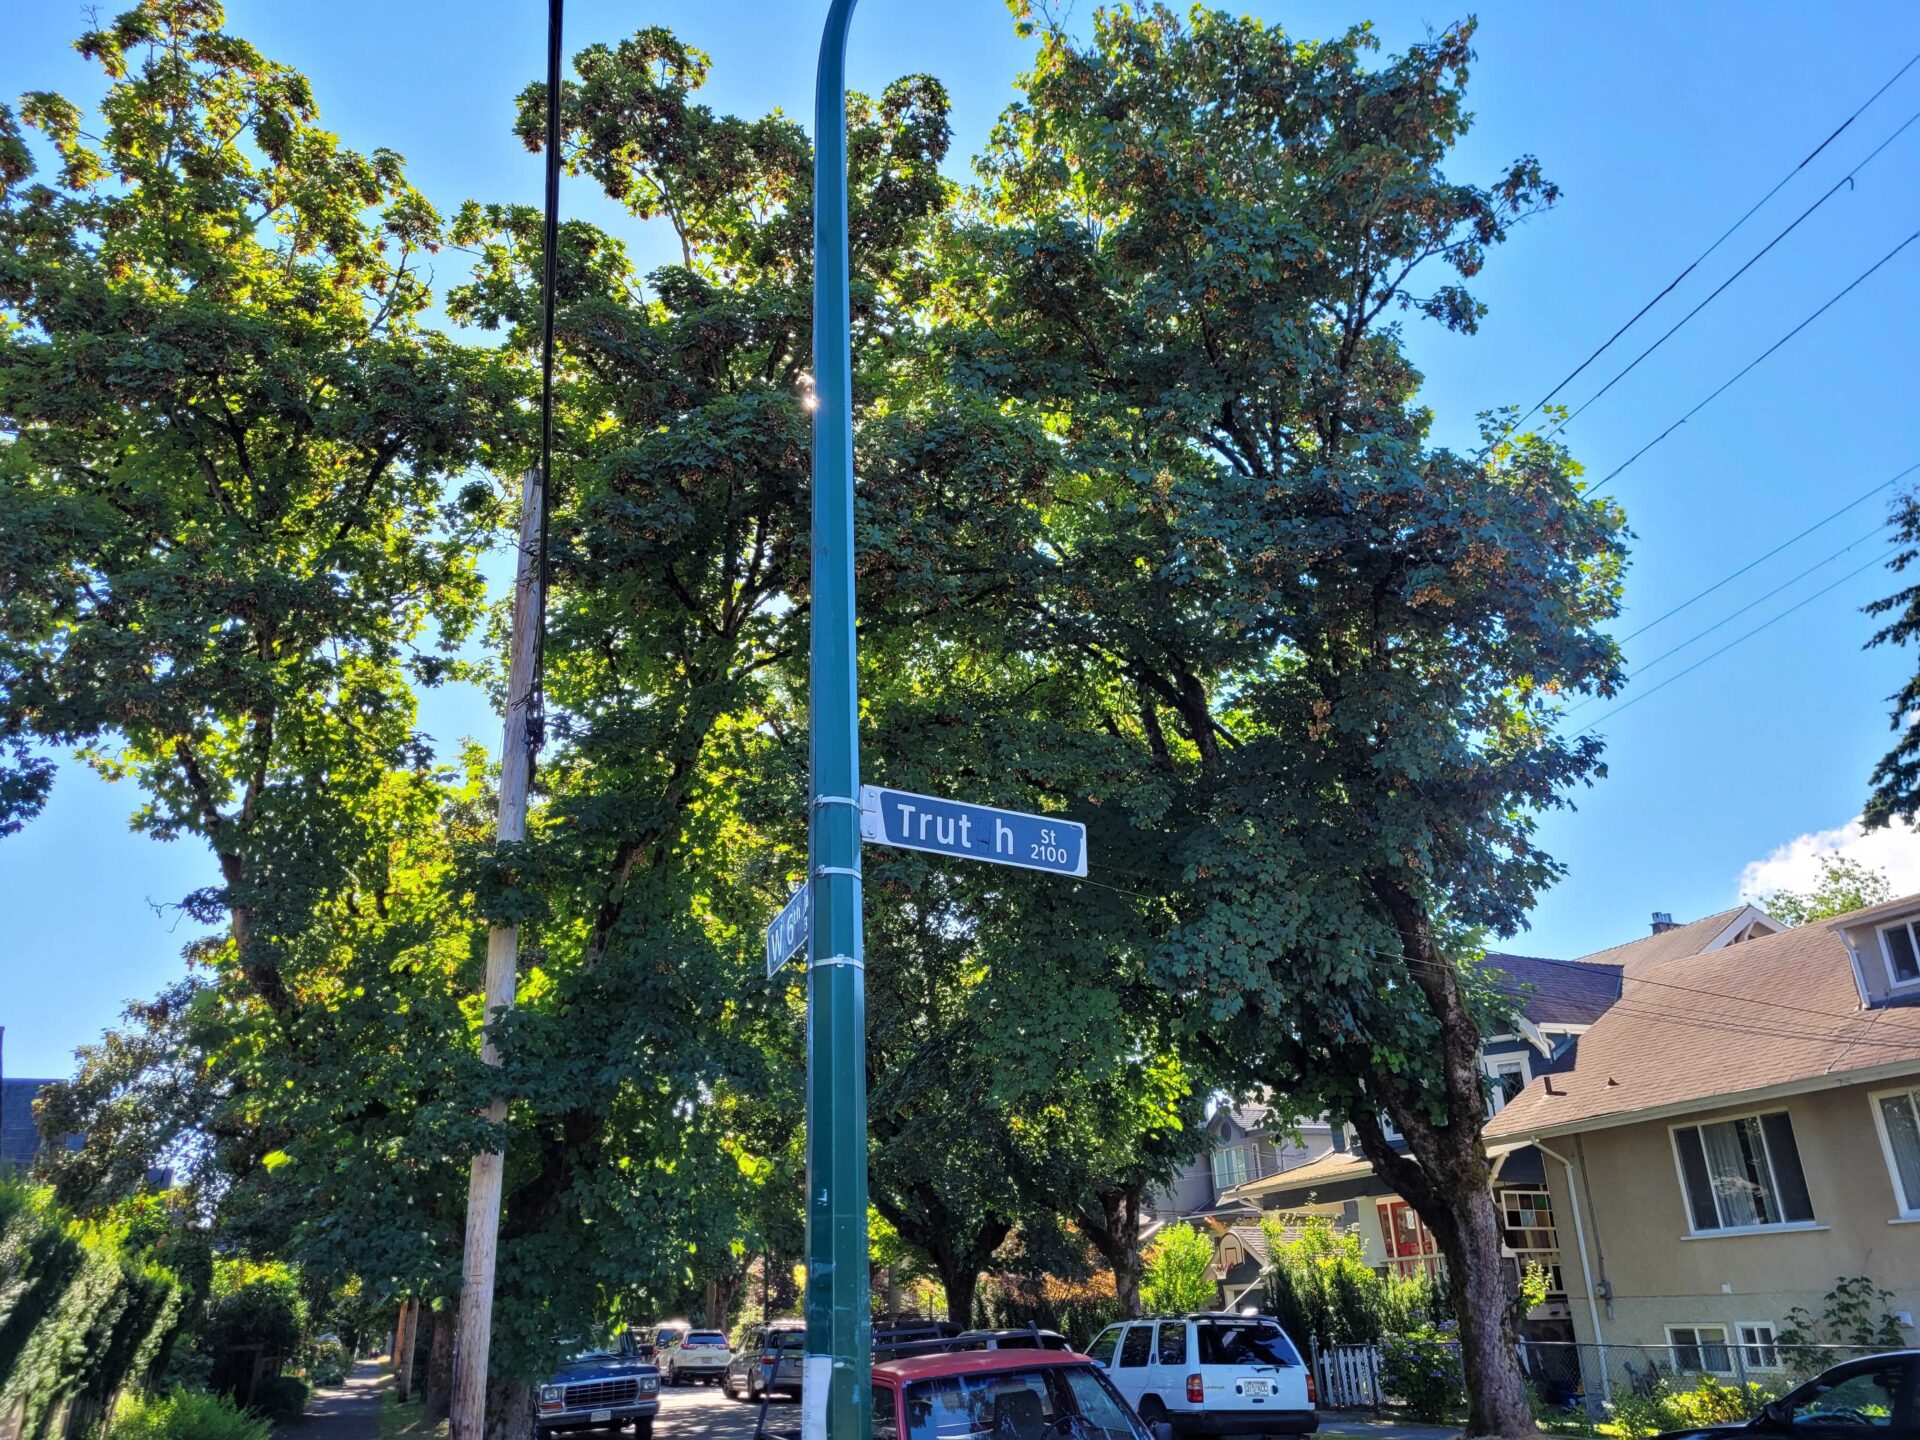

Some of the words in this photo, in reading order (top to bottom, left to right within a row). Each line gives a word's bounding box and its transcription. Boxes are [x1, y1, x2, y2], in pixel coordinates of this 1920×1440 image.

[1040, 829, 1057, 846] St
[1030, 844, 1068, 864] 2100
[770, 923, 783, 962] W
[786, 905, 801, 946] 6th
